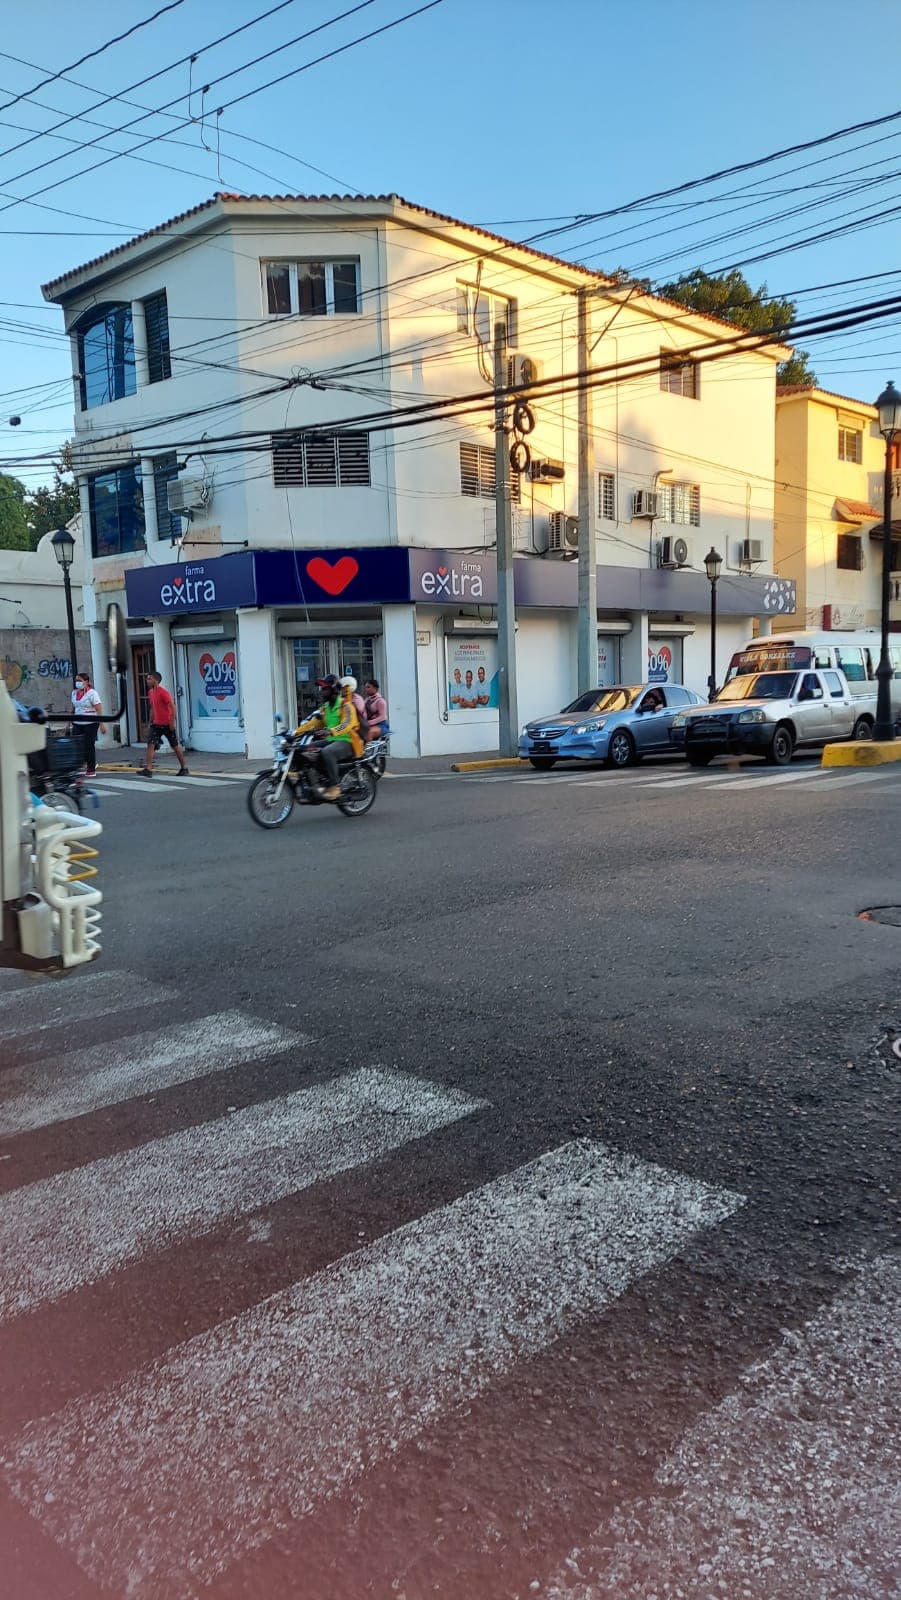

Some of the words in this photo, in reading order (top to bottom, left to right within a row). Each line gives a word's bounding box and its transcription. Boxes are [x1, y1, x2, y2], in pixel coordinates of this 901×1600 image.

[185, 565, 204, 576] farma
[461, 560, 481, 572] farma
[161, 577, 216, 606] extra
[421, 569, 483, 597] extra
[648, 654, 669, 671] 0%
[203, 662, 237, 682] 20%
